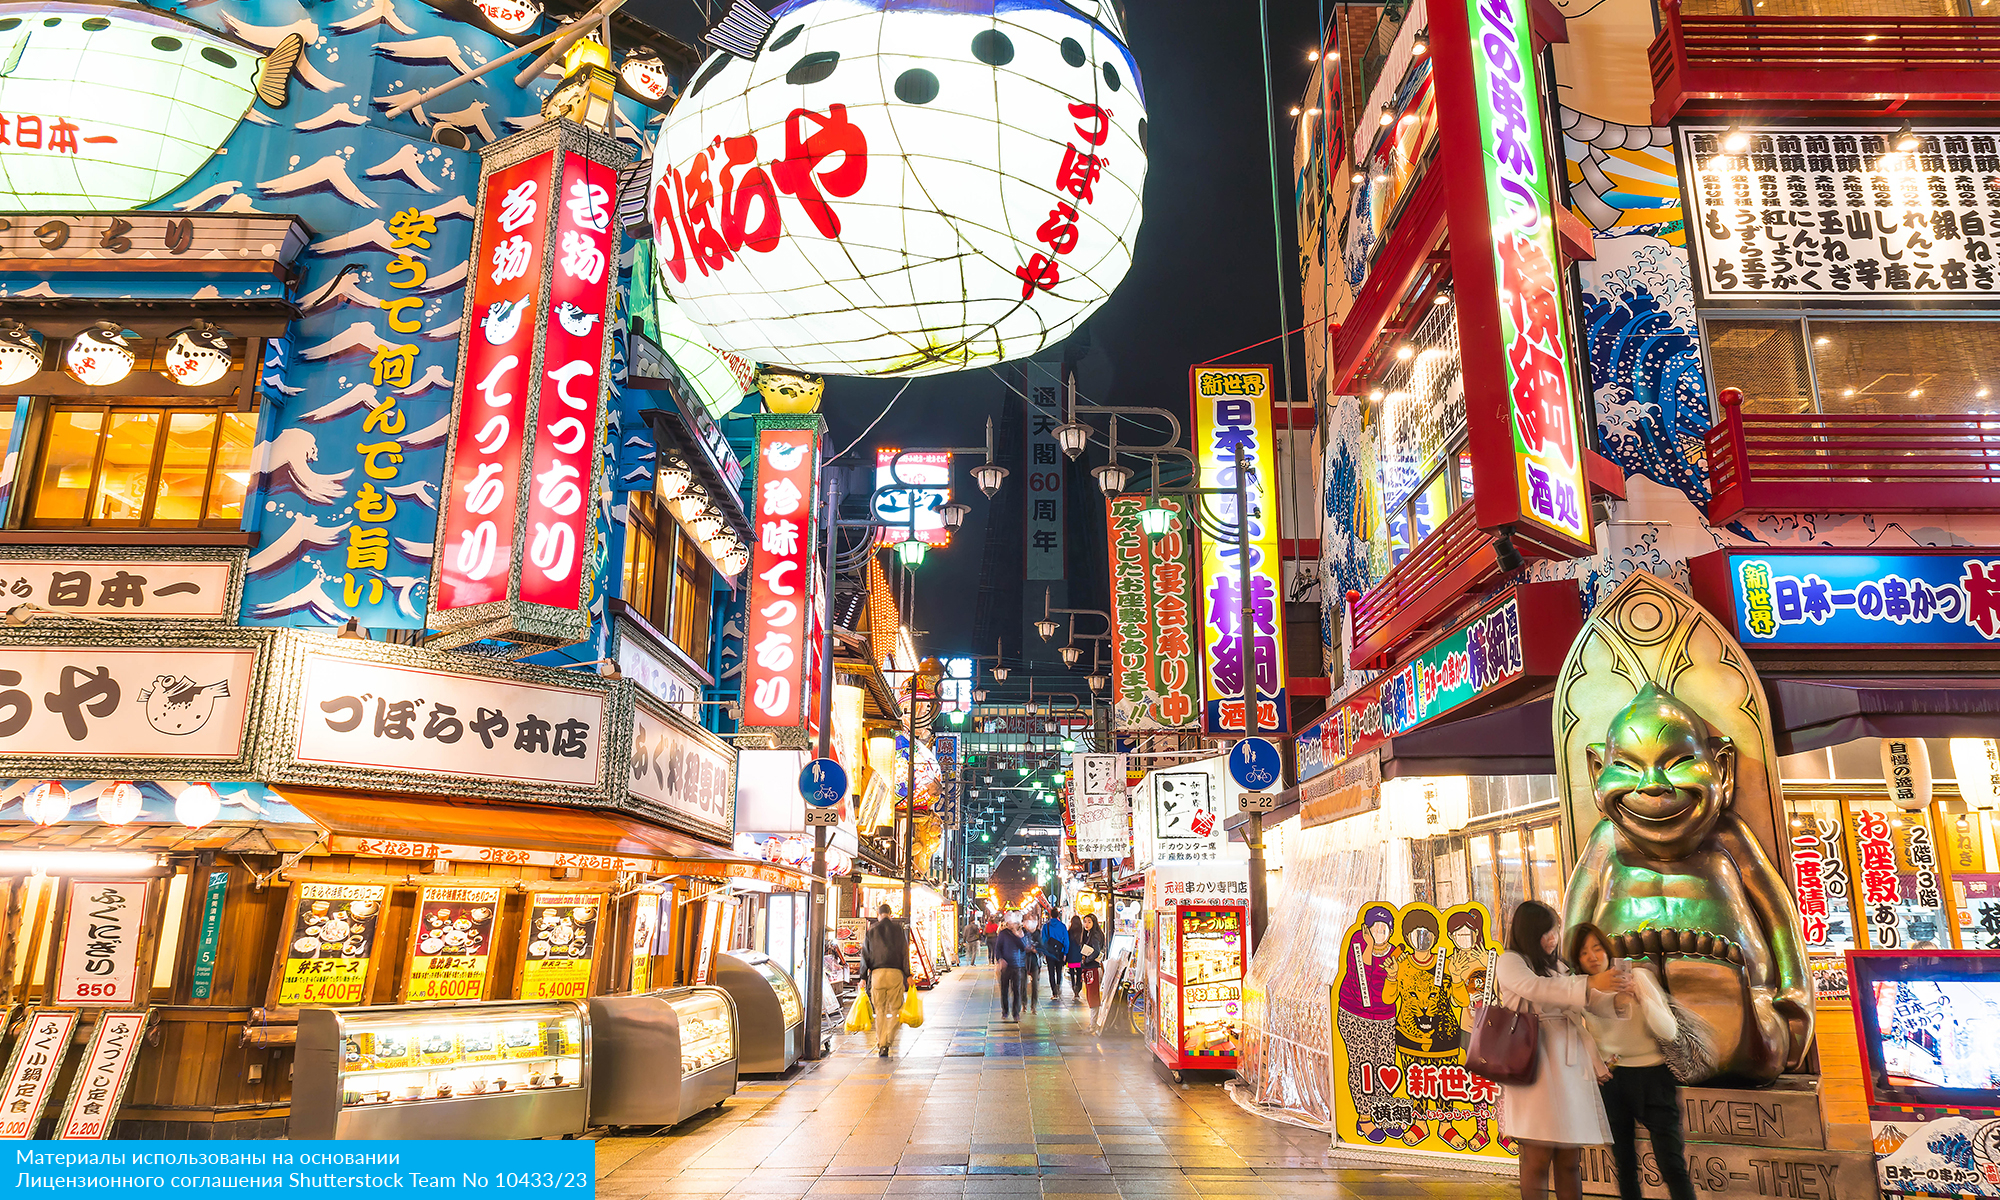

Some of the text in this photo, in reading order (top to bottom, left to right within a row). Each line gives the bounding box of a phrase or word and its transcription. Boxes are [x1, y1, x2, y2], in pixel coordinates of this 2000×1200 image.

[1750, 135, 1778, 172] 前頭
[1776, 135, 1806, 172] 前頭
[1804, 135, 1834, 172] 前頭
[1832, 135, 1862, 172] 前頭
[0, 217, 193, 254] っちり
[1015, 103, 1115, 300] づぼらや
[1943, 136, 1974, 173] 前頭
[1960, 210, 1996, 290] 白ねぎ
[1705, 209, 1738, 289] もち
[1735, 209, 1769, 289] うずら玉子
[1760, 209, 1798, 289] 紅しょうが
[1789, 210, 1822, 290] にんにく
[1817, 210, 1853, 290] 玉ねぎ
[1846, 210, 1881, 290] 山芋
[1874, 210, 1911, 290] しし唐
[1903, 210, 1941, 290] れんこん
[1930, 210, 1968, 290] 銀杏
[1200, 372, 1266, 396] 新世界
[1497, 232, 1575, 475] 横綱
[343, 207, 436, 608] 安うて何んでも旨い
[457, 354, 519, 582] てっちり
[530, 358, 594, 582] てっちり
[1029, 386, 1061, 553] 通天閣60周年
[1526, 462, 1580, 532] 酒処
[0, 570, 201, 608] ら日本一
[752, 477, 803, 717] 珍味てっちり
[1744, 564, 1775, 635] 新世界
[1775, 578, 1964, 623] 日本一の串かつ
[320, 692, 590, 760] づぼらや本店
[1240, 797, 1273, 808] 9-22
[1889, 740, 1915, 800] 自慢の逸品
[358, 838, 453, 859] ふぐなら日本一
[479, 848, 531, 865] づぼらや
[555, 854, 637, 871] ふぐなら日本一
[1793, 820, 1847, 944] 二度漬け ソースの
[1859, 810, 1900, 949] お座敷あり
[1911, 827, 1939, 908] 2階・3階
[1164, 881, 1248, 894] 元祖串カツ専門店
[85, 887, 127, 976] ふぐにぎり
[202, 951, 210, 963] 5
[76, 982, 117, 997] 850
[304, 984, 362, 1001] 5,400円
[427, 980, 480, 998] 8,600円
[538, 981, 586, 999] 5,400円
[10, 1021, 59, 1114] ふぐ小鍋定食
[83, 1022, 130, 1116] ふぐづくし定食
[1360, 1063, 1501, 1104] I 新世界
[70, 1121, 101, 1135] 2,200
[1686, 1099, 1786, 1138] IKEN
[1885, 1165, 1980, 1184] 日本一の串かつ
